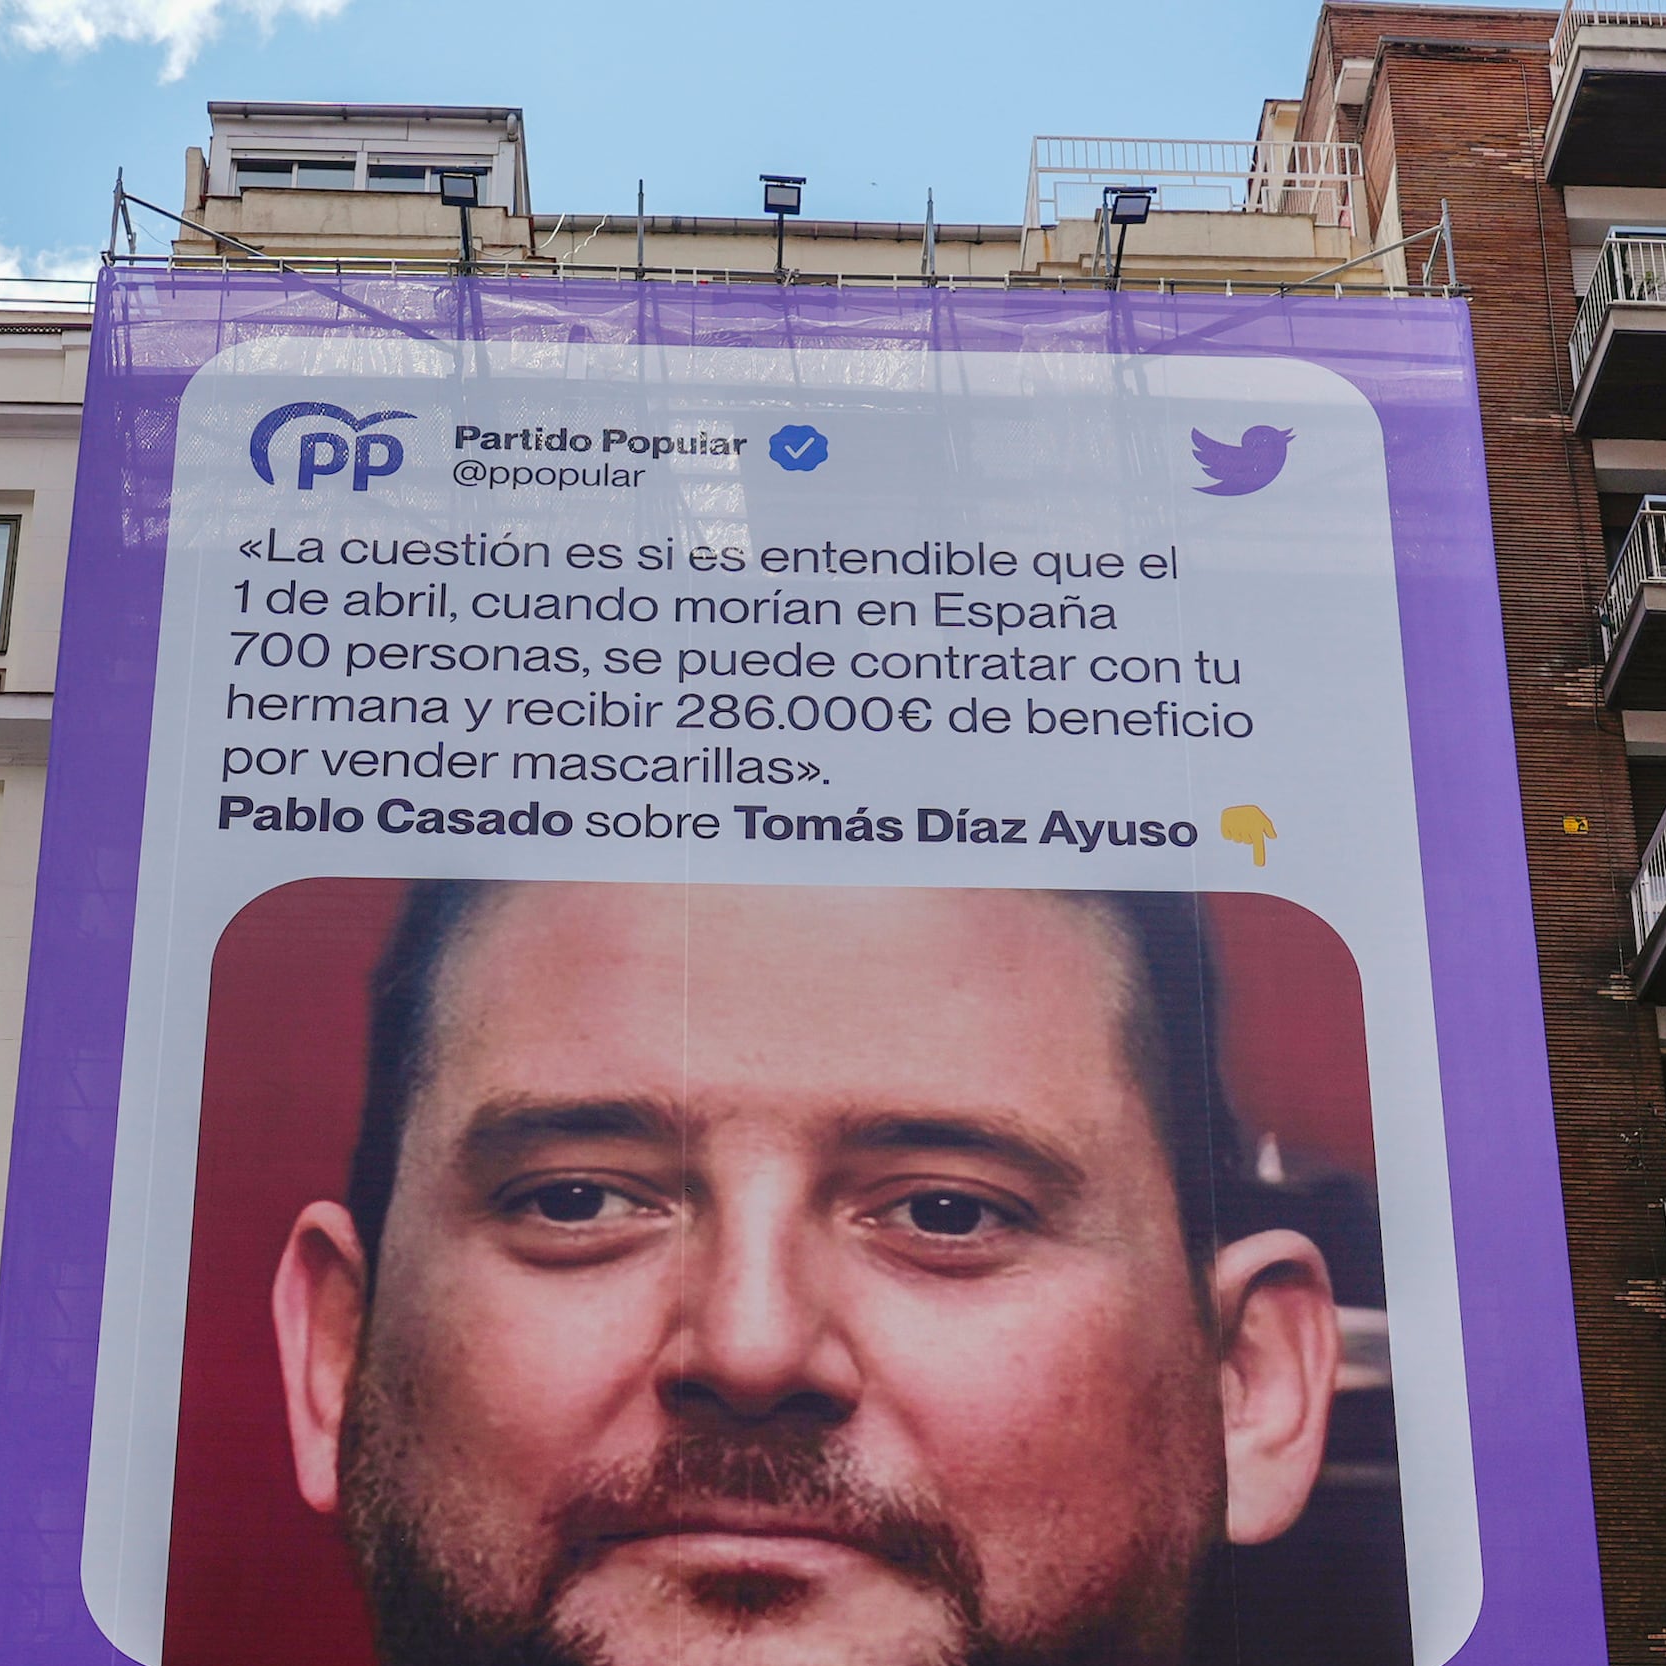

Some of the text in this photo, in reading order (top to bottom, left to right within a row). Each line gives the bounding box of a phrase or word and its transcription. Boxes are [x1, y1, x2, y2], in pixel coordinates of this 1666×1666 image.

[454, 425, 747, 461] Partido Popular
[453, 462, 646, 492] @ppopular
[240, 528, 1177, 585] «La cuestión es si es entendible que el
[235, 580, 1117, 636] 1 de abril, cuando morían en España
[231, 632, 1240, 684] 700 personas, se puede contratar con tu
[227, 684, 1253, 738] hermana y recibir 286.000€ de beneficio
[223, 742, 829, 784] por vender mascarillas».
[219, 796, 1197, 853] Pablo Casado sobre Tomás Díaz Ayuso
